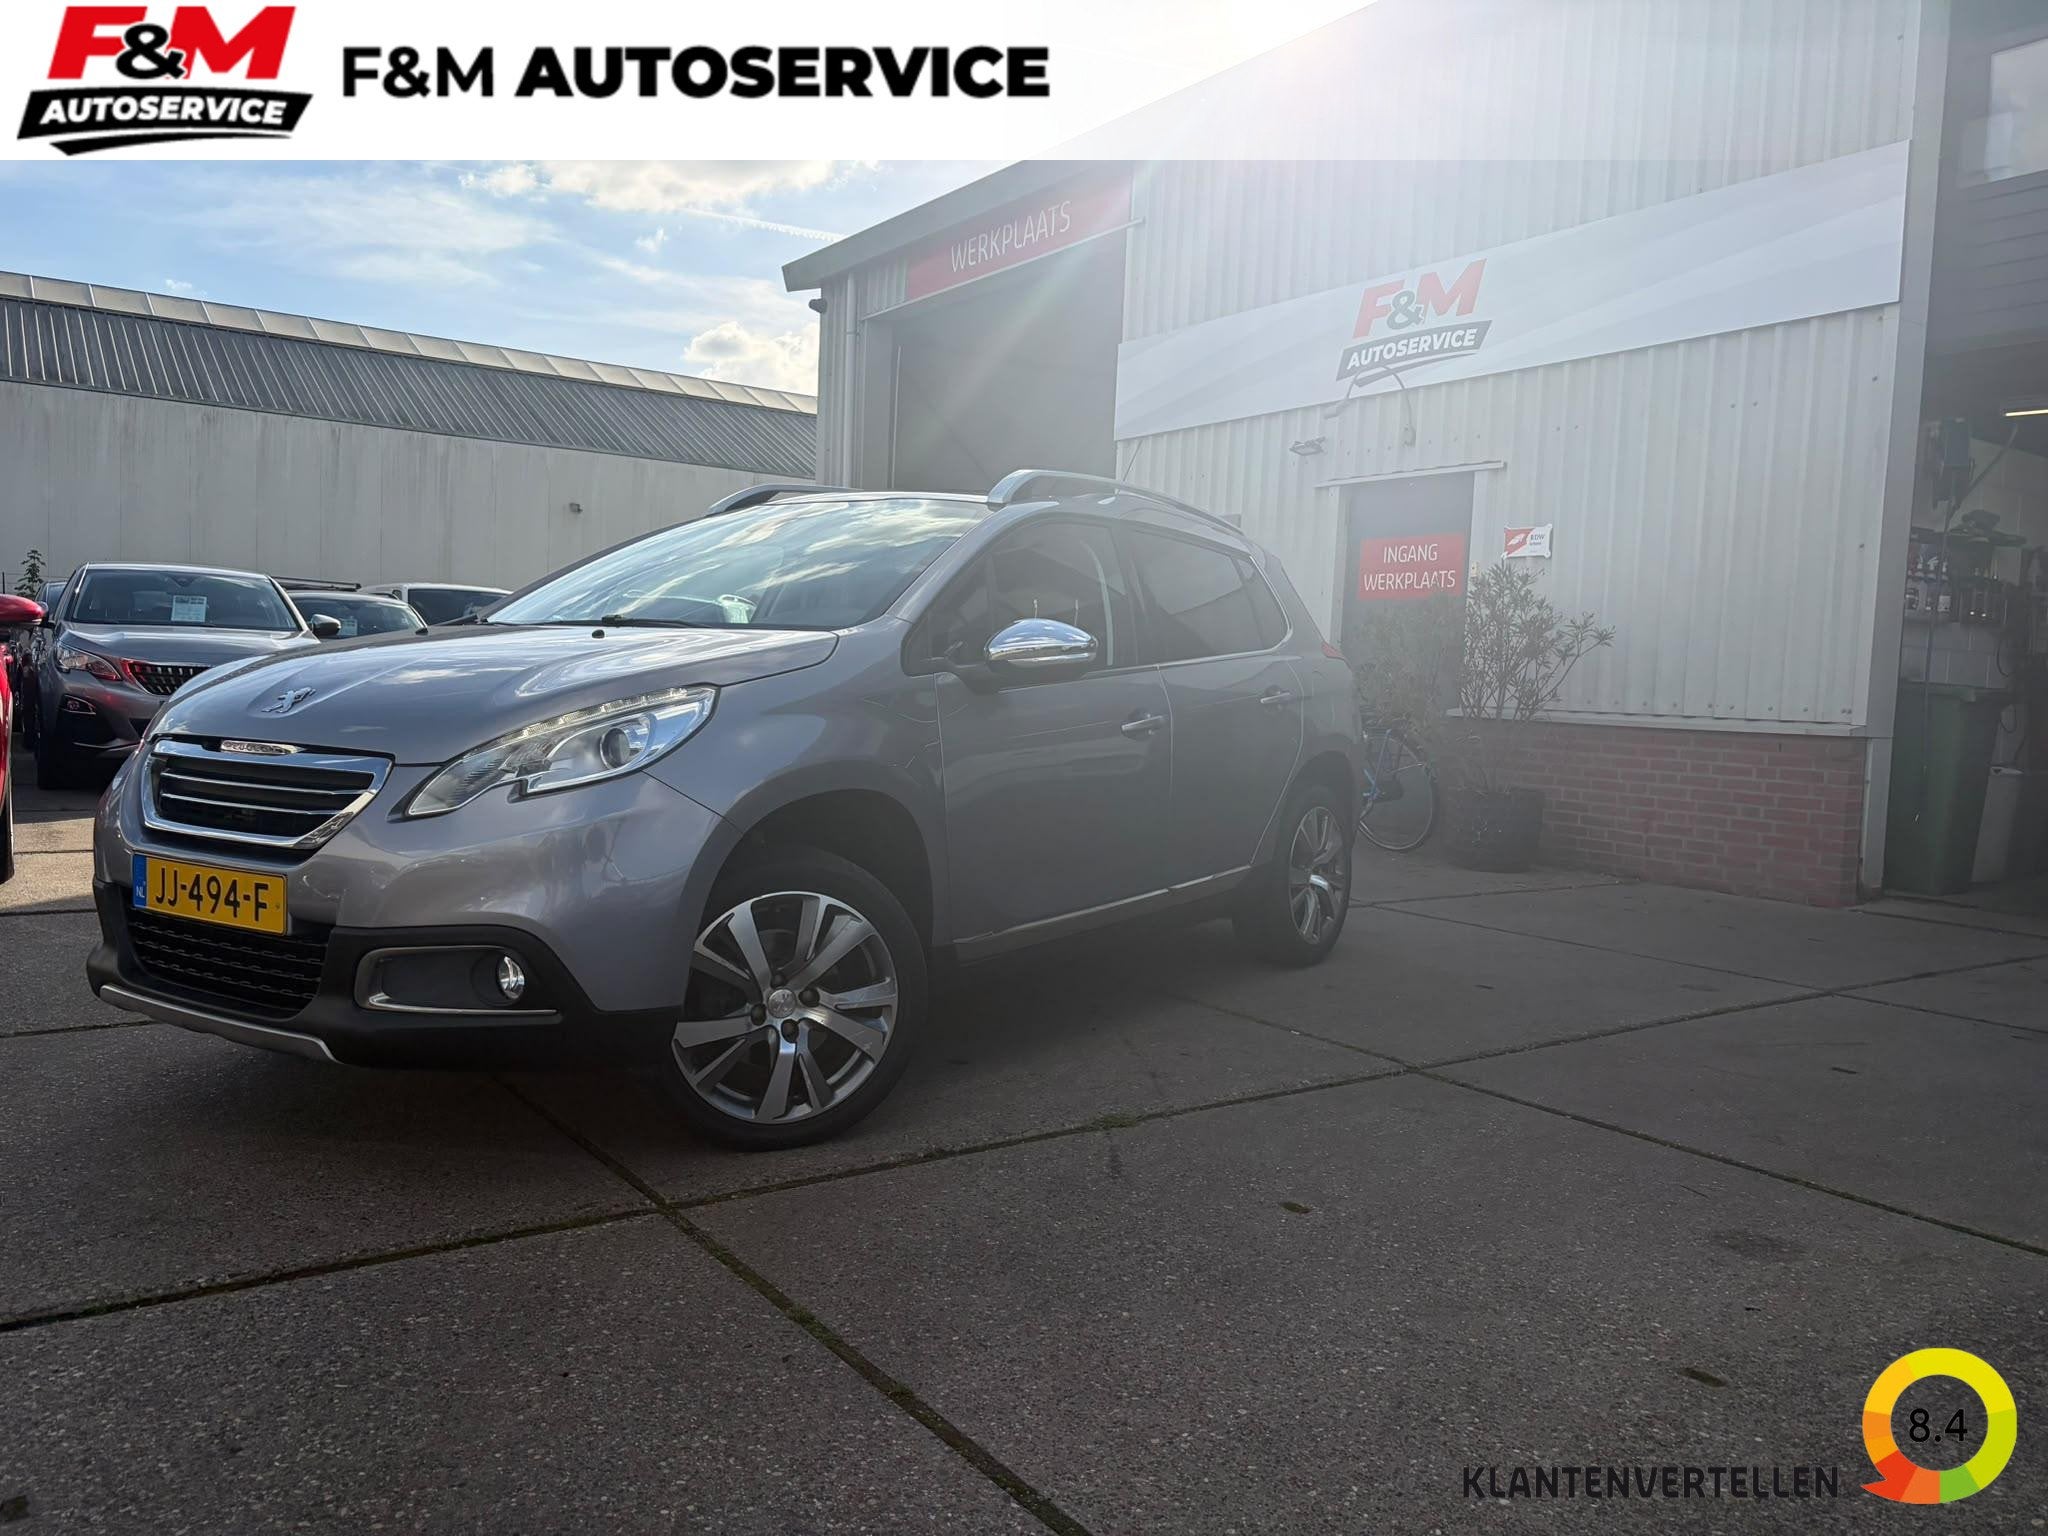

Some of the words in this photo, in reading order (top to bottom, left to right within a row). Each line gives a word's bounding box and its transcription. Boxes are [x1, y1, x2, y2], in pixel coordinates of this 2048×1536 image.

[951, 200, 1072, 273] WERKPLAATS
[1352, 258, 1488, 339] F&M
[1346, 328, 1478, 370] AUTOSERVICE
[1383, 543, 1439, 564] INGANG
[1363, 570, 1456, 591] WERKPLAATS
[135, 886, 145, 898] NL
[155, 867, 269, 922] JJ-494-F
